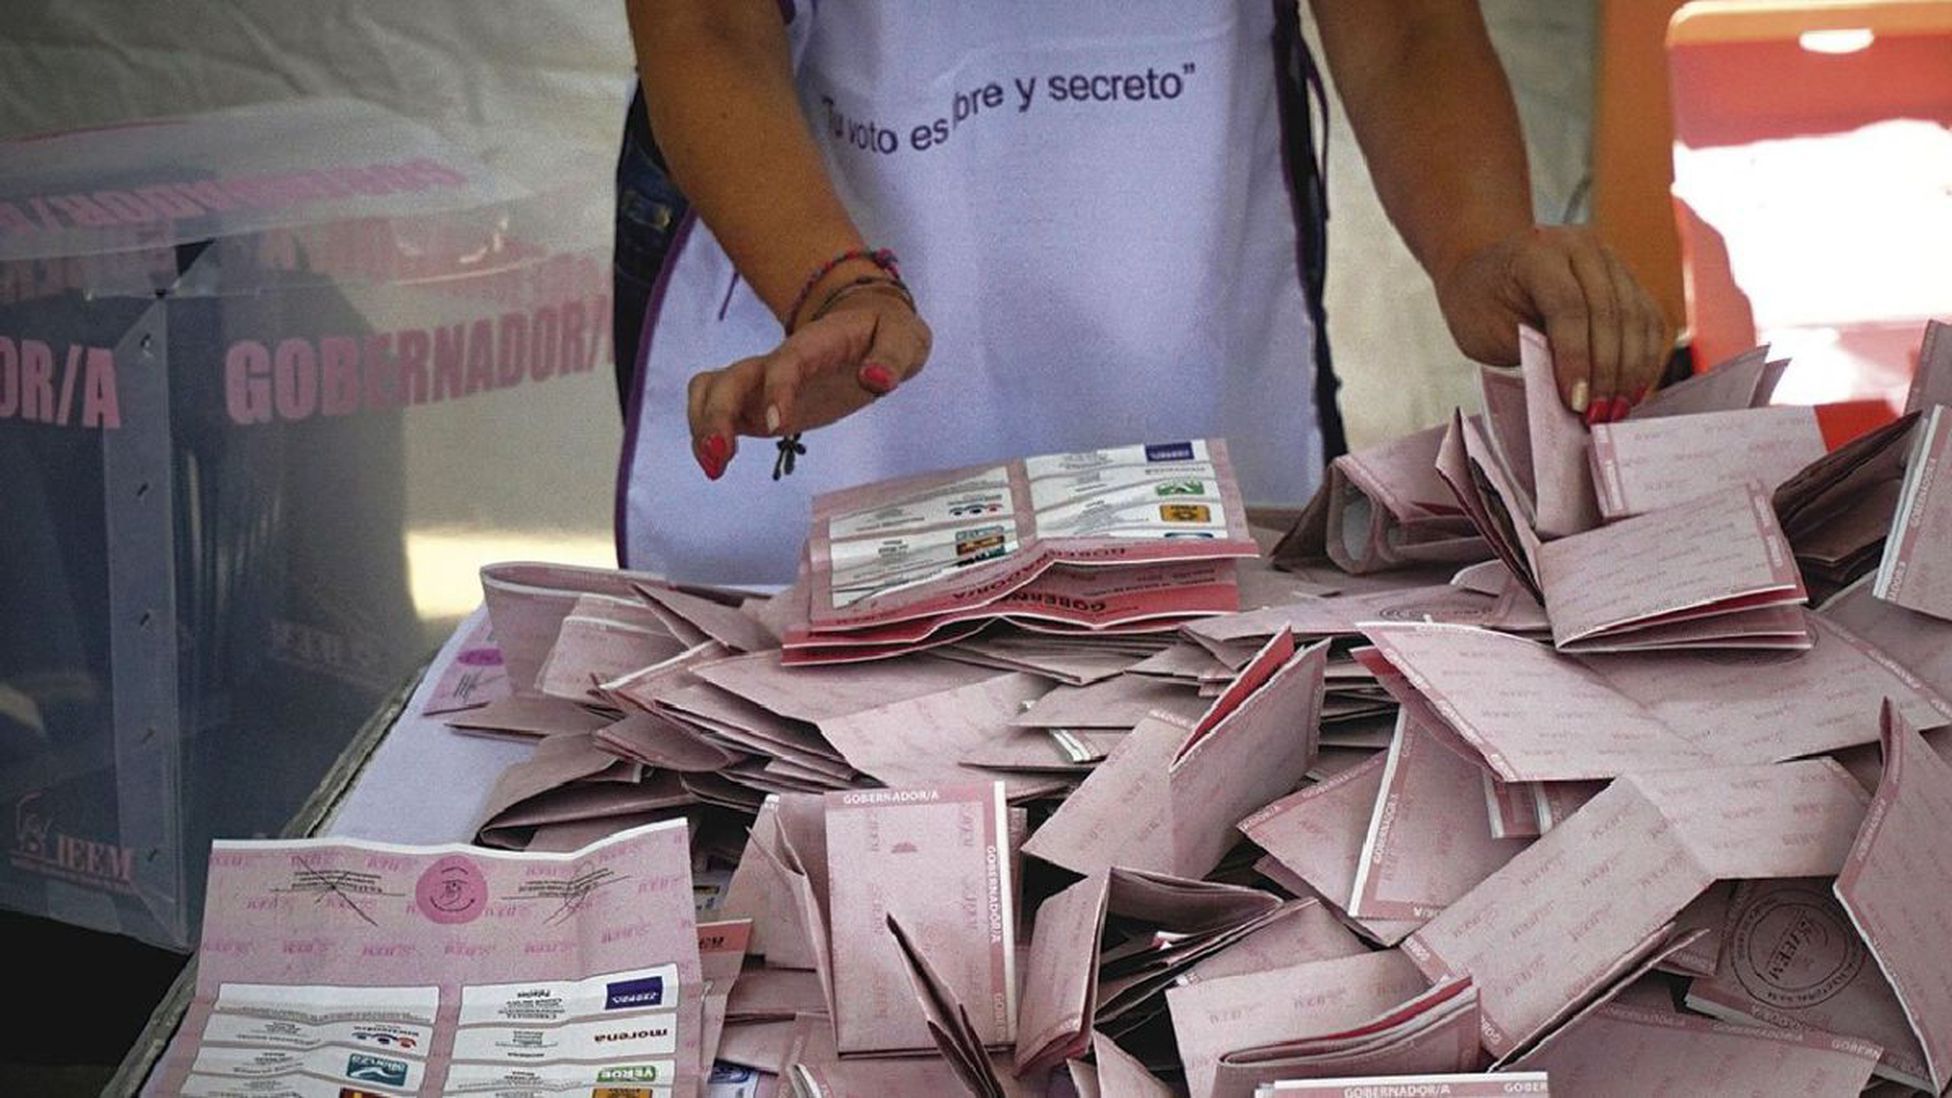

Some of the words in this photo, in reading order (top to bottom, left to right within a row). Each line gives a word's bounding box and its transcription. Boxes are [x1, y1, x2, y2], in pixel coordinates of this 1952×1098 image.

[848, 117, 899, 154] voto
[910, 118, 949, 151] es
[1015, 76, 1037, 112] y
[225, 294, 614, 425] GOBERNADOR/
[843, 789, 940, 804] GOBERNADOR/A
[986, 845, 1001, 944] GOBERNADOR/A
[593, 1028, 668, 1042] morena
[1344, 1084, 1451, 1098] GOBERNADOR/A
